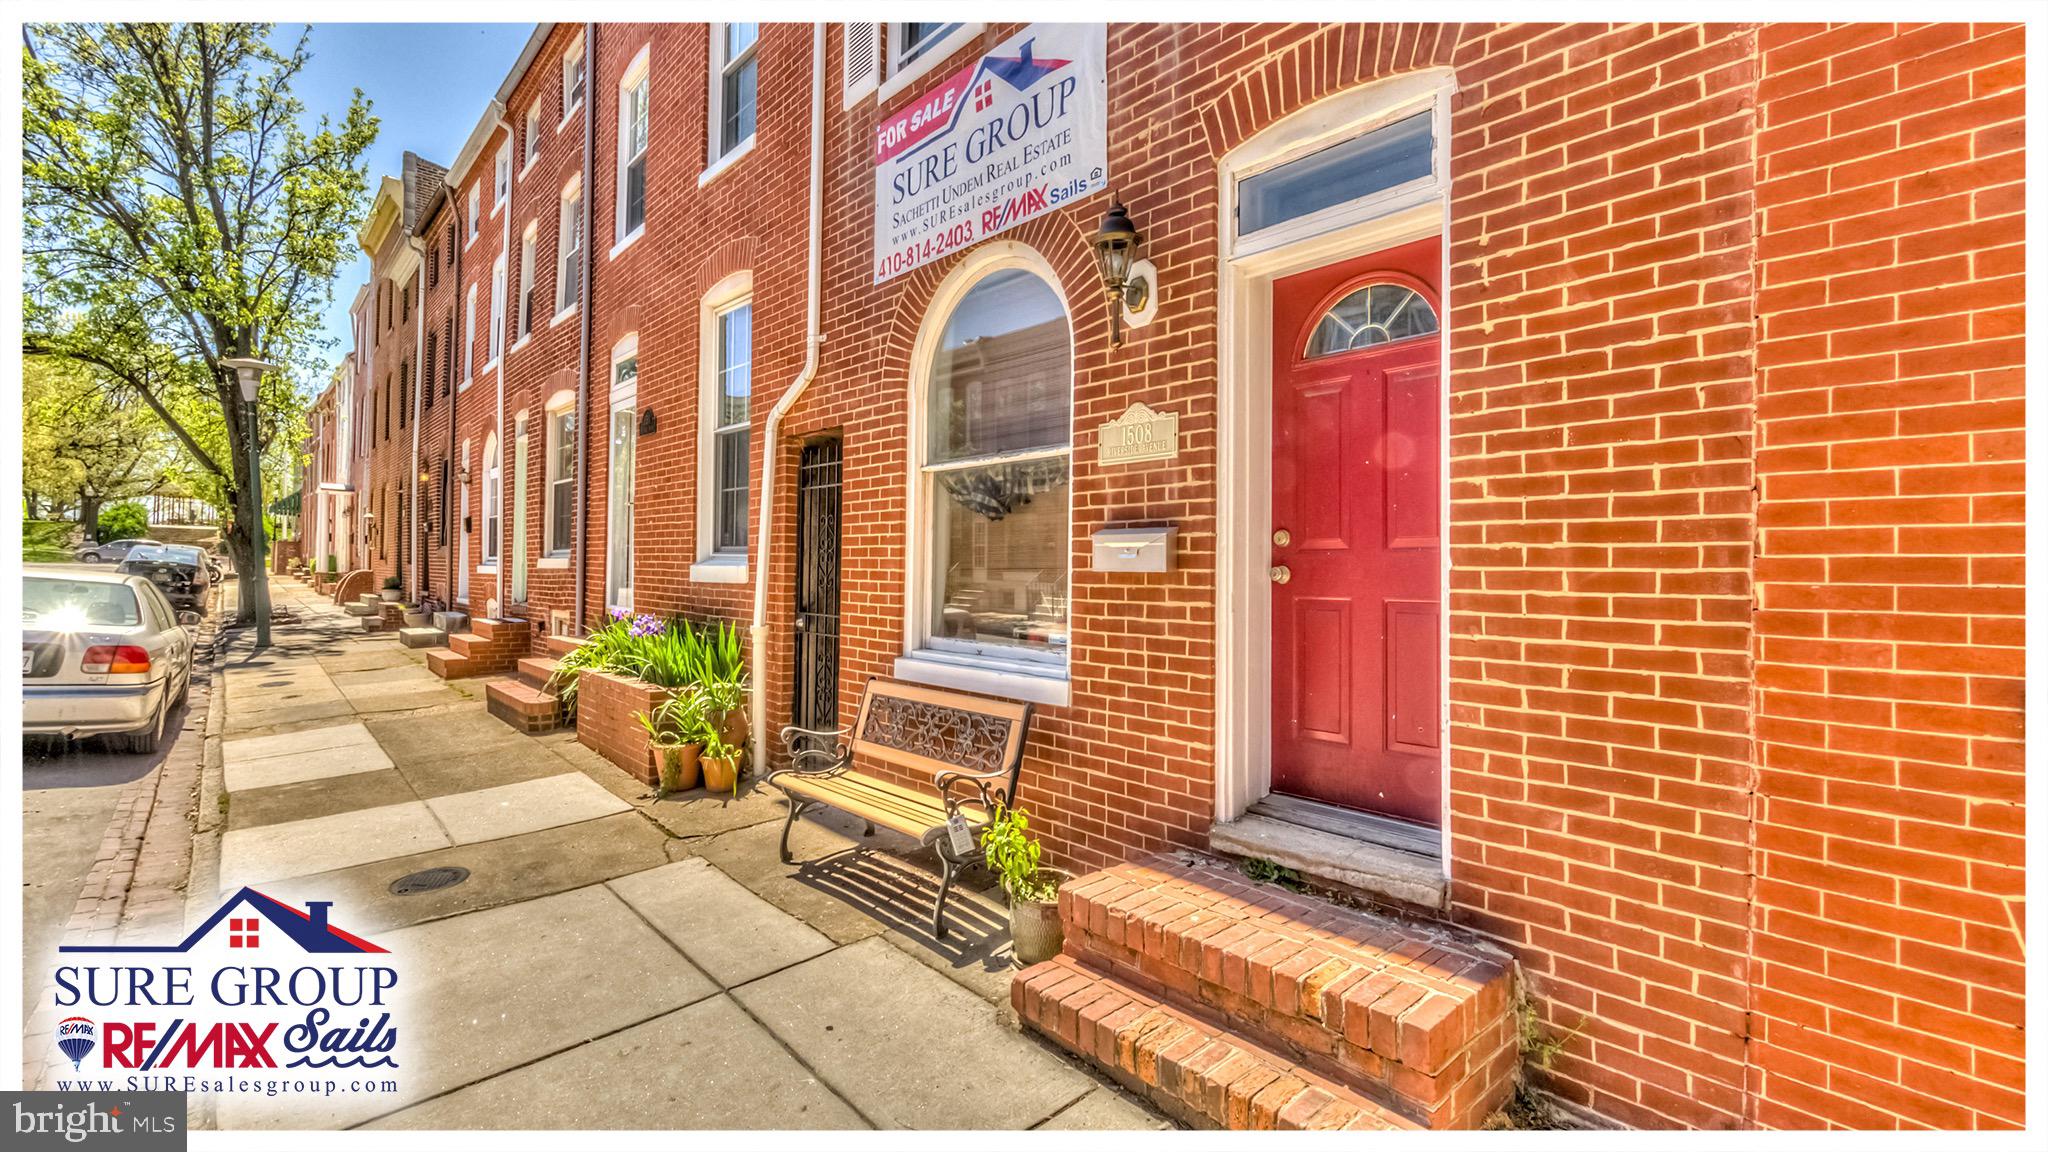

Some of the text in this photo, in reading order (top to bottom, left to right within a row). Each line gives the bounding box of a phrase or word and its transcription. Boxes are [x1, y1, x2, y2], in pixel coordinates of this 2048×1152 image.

[877, 88, 955, 155] FOR SALE
[893, 76, 1076, 205] SURE GROUP
[878, 178, 1088, 279] 410-814-2403 RE/MAX Sails
[891, 152, 1072, 246] www.SUREsalesgroup.com
[892, 196, 940, 230] SACHETTI
[942, 173, 983, 204] UNDEM
[1122, 422, 1153, 446] 1508
